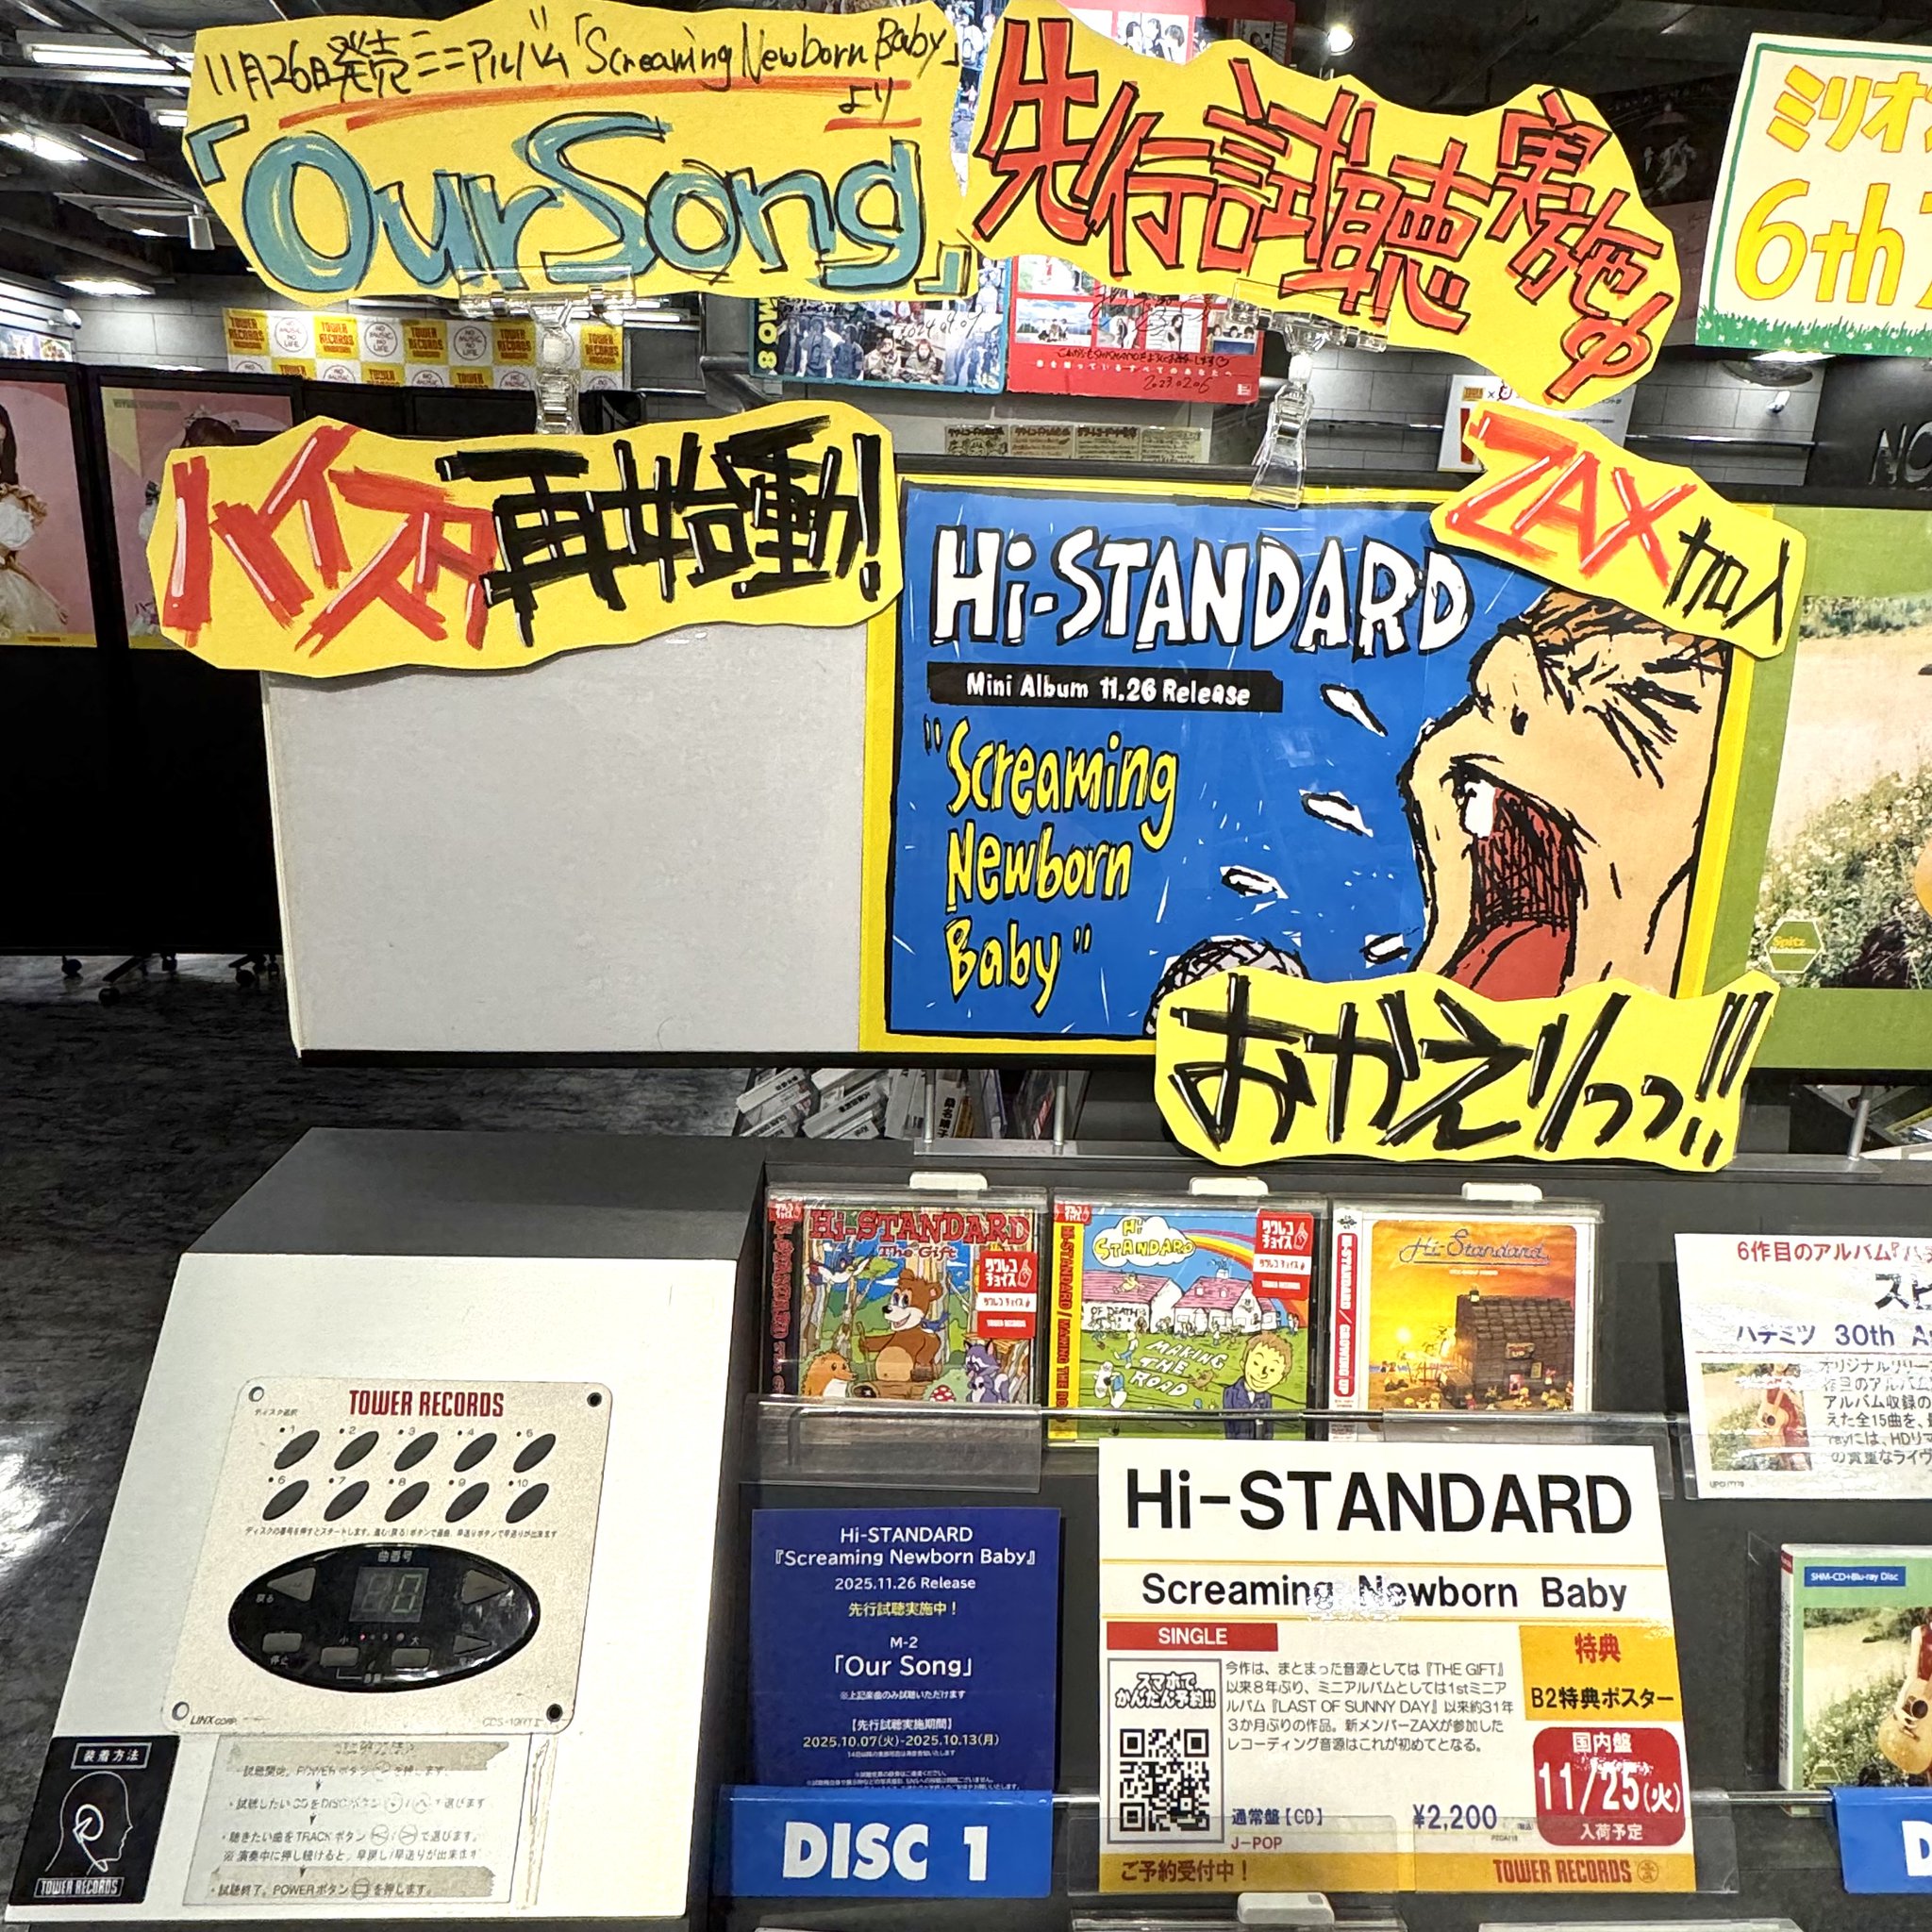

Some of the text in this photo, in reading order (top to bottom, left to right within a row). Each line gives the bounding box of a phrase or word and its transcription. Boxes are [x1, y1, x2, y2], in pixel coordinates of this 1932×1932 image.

[838, 77, 893, 125] より
[1766, 64, 1932, 153] ミリオ
[1735, 178, 1905, 305] 6th
[932, 526, 1474, 659] Hi-STANDARD
[966, 672, 1251, 708] Mini Album 11.26 Release
[946, 821, 1133, 913] Newborn
[808, 1208, 1031, 1245] Hi-STANDARD
[1122, 1220, 1143, 1235] Hi
[877, 1245, 958, 1260] The Gift
[1399, 1228, 1550, 1262] Hi-Standard
[1835, 1324, 1895, 1346] 30th
[1139, 1357, 1191, 1375] THE
[1145, 1340, 1228, 1371] MAKING
[1055, 1366, 1070, 1389] THE
[1129, 1371, 1189, 1397] ROAD
[349, 1390, 505, 1417] TOWER RECORDS
[517, 1478, 529, 1488] 10
[1126, 1468, 1633, 1534] Hi-STANDARD
[841, 1526, 974, 1544] Hi-STANDARD
[774, 1548, 1037, 1568] 『Screaming Newborn Baby』
[835, 1576, 976, 1591] 2025.11.26 Release
[1880, 1572, 1899, 1582] Disc
[1141, 1573, 1628, 1614] Screaming Newborn Baby
[890, 1636, 919, 1649] M-2
[1158, 1626, 1229, 1645] SINGLE
[1574, 1632, 1622, 1664] 特典
[835, 1654, 974, 1680] 「Our Song」
[1137, 1671, 1197, 1691] スマホで
[1321, 1700, 1341, 1712] OF
[1345, 1700, 1395, 1713] SUNNY
[1531, 1687, 1674, 1710] B2特典ポスター
[1227, 1737, 1482, 1752] レコーディング音源はこれが初めてとなる。
[1572, 1731, 1633, 1754] 国内盤
[1539, 1757, 1682, 1815] 11/25(火)
[1412, 1804, 1498, 1832] ¥2,200
[1230, 1836, 1283, 1851] J-POP
[1579, 1823, 1643, 1841] 入荷予定
[782, 1821, 990, 1881] DISC 1
[1493, 1858, 1632, 1885] TOWER RECORDS
[41, 1878, 119, 1896] TOWER RECORDS
